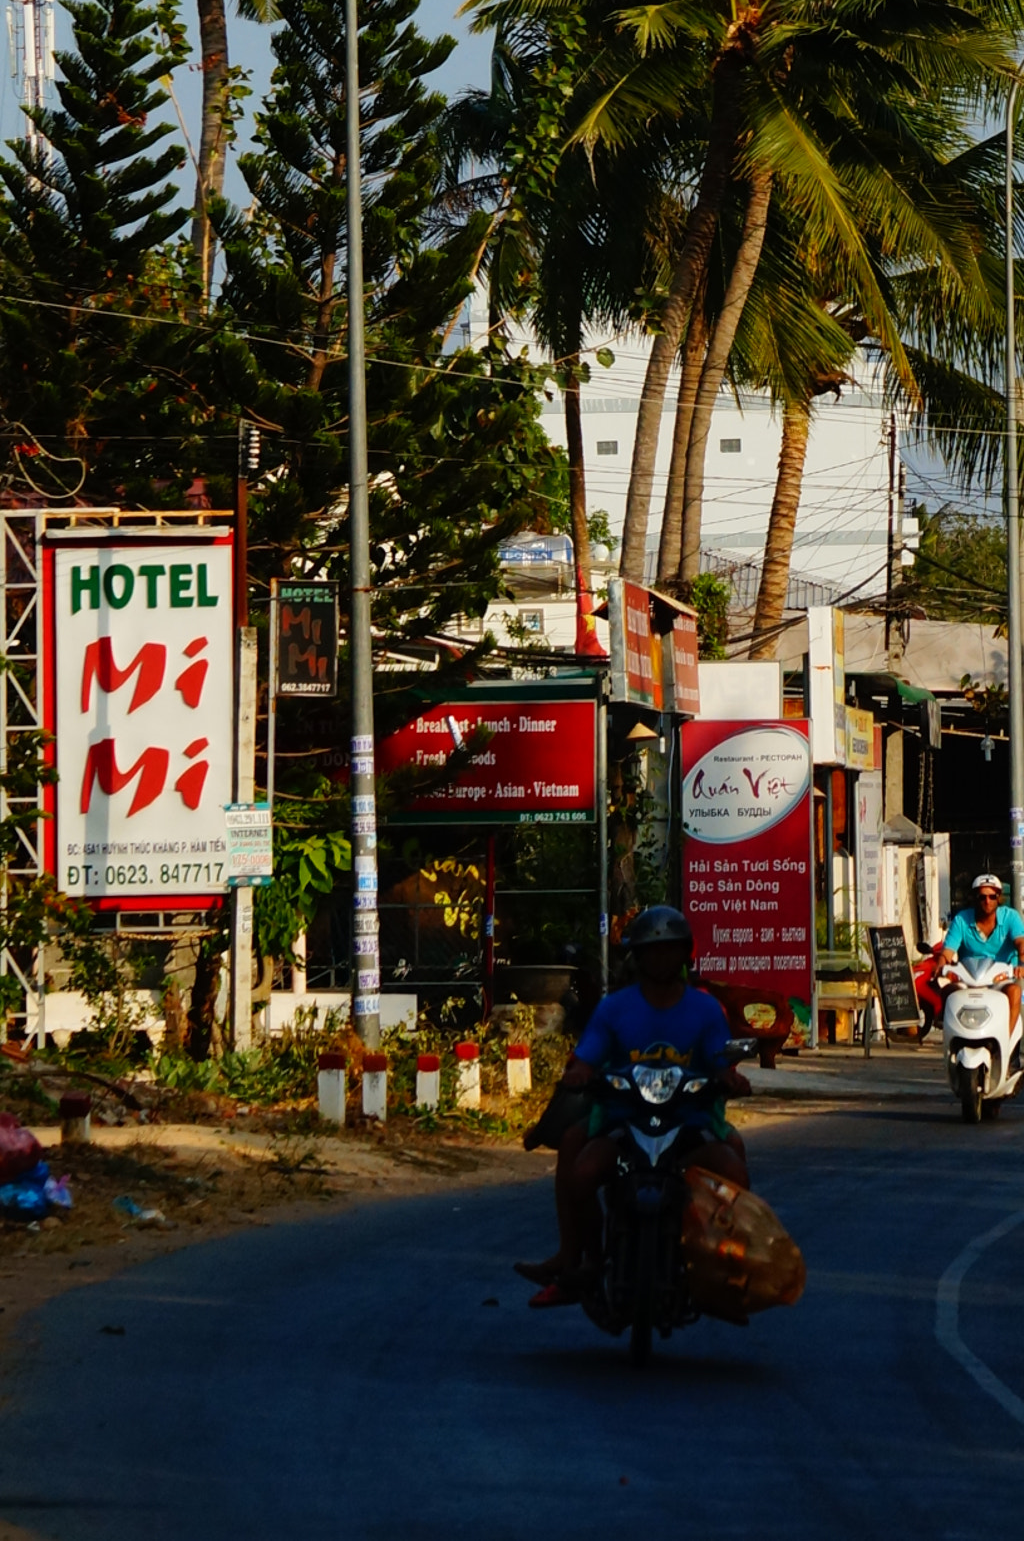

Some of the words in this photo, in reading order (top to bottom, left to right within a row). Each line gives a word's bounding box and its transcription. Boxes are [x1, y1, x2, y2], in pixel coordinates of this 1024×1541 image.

[71, 563, 219, 615] HOTEL
[281, 587, 334, 603] HOTEL
[519, 717, 556, 733] Dinner
[416, 749, 446, 766] Fresh
[448, 781, 486, 802] Europe
[494, 781, 525, 798] Asian
[533, 781, 579, 798] Vietnam
[693, 768, 739, 800] Quán
[742, 767, 797, 800] Việt
[556, 813, 570, 821] 743
[689, 807, 730, 818] УЛЫБКА
[737, 807, 772, 818] БУДДЫ
[230, 829, 268, 838] INTERNET
[130, 838, 151, 854] THÚC
[153, 837, 180, 854] KHÁNG
[181, 842, 187, 852] P.
[191, 837, 207, 852] HÀM
[689, 859, 710, 873] Hải
[714, 858, 738, 872] Sản
[742, 859, 769, 872] Tươi
[773, 857, 806, 874] Sống
[67, 865, 99, 886] ĐT:
[105, 864, 153, 885] 0623.
[160, 863, 224, 884] 847717
[689, 880, 714, 895] Đặc
[718, 878, 742, 892] Sản
[746, 879, 780, 894] Dông
[689, 900, 718, 912] Cơm
[722, 899, 747, 913] Việt
[750, 900, 778, 911] Nam
